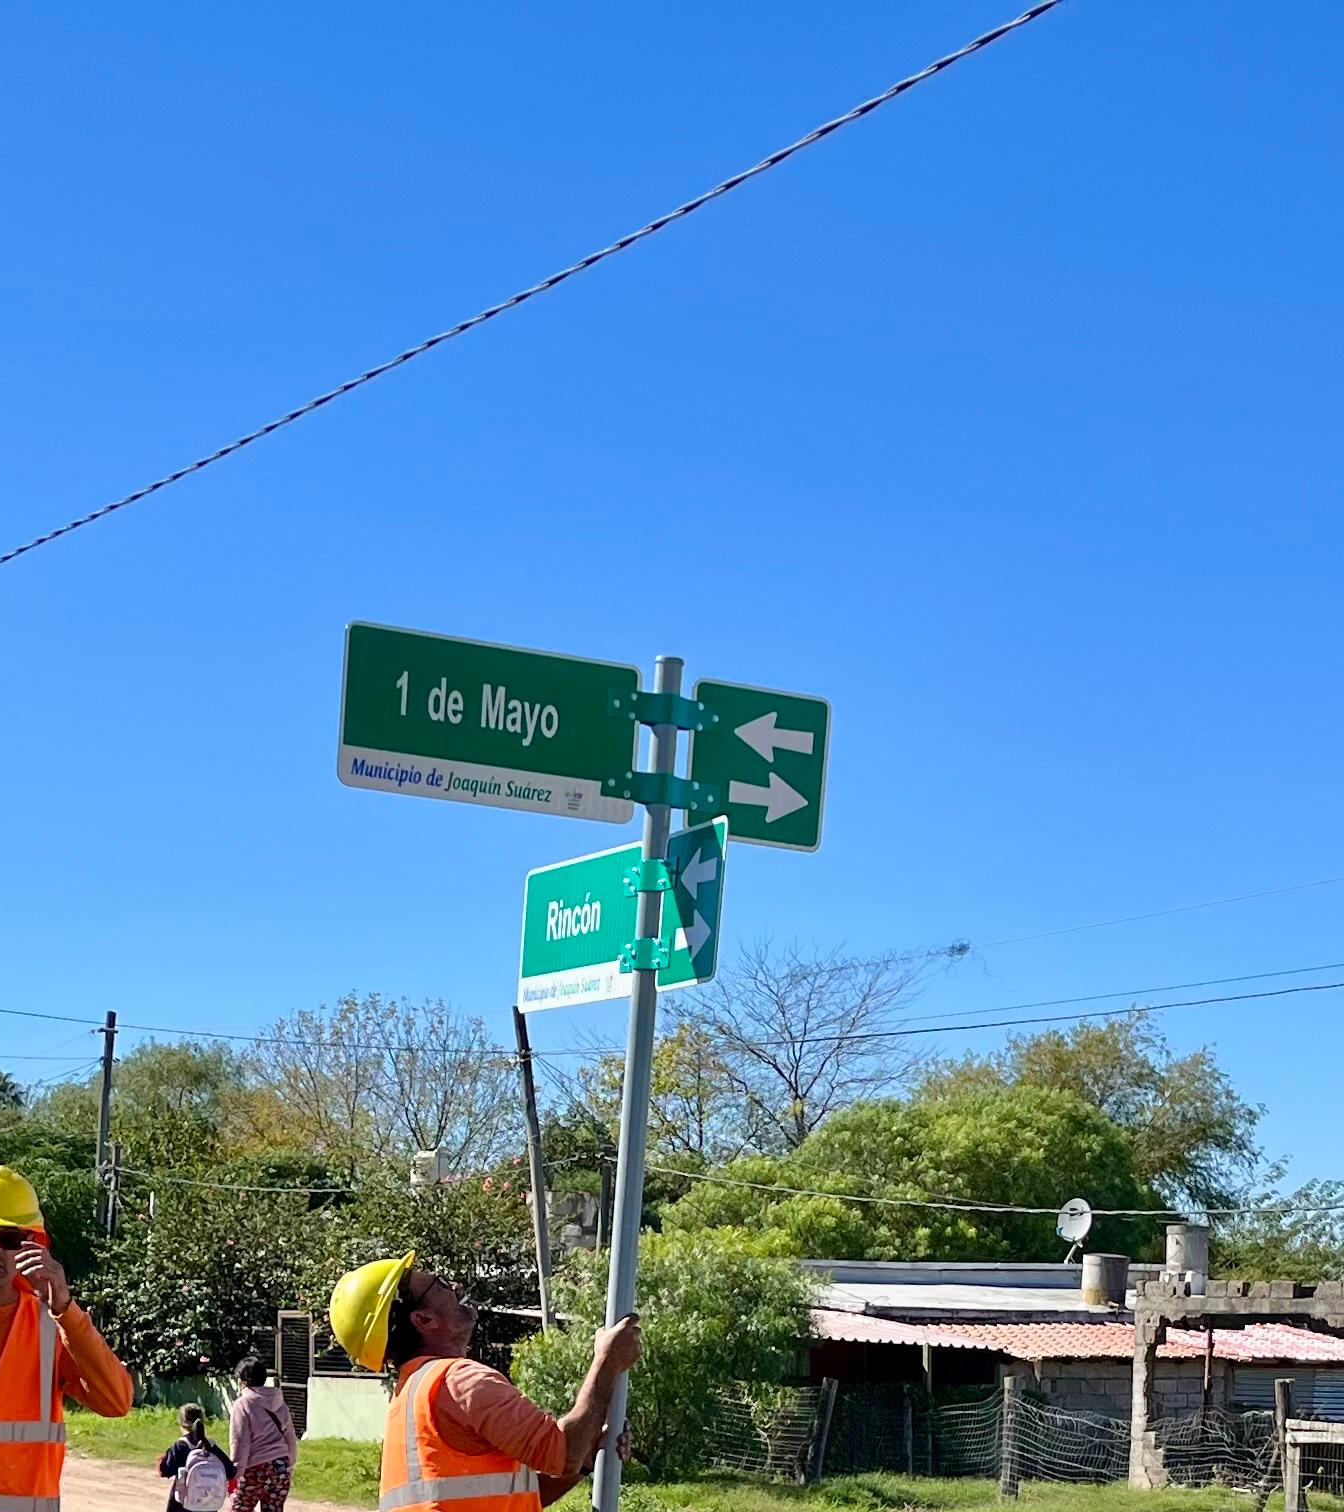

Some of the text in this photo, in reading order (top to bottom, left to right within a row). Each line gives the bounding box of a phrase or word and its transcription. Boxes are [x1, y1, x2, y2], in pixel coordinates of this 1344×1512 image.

[395, 671, 559, 746] 1 de Mayo
[350, 757, 422, 787] Municipio
[426, 767, 444, 787] de
[444, 771, 501, 798] Joaquín
[505, 780, 553, 803] Suárez
[546, 892, 601, 941] Rincón
